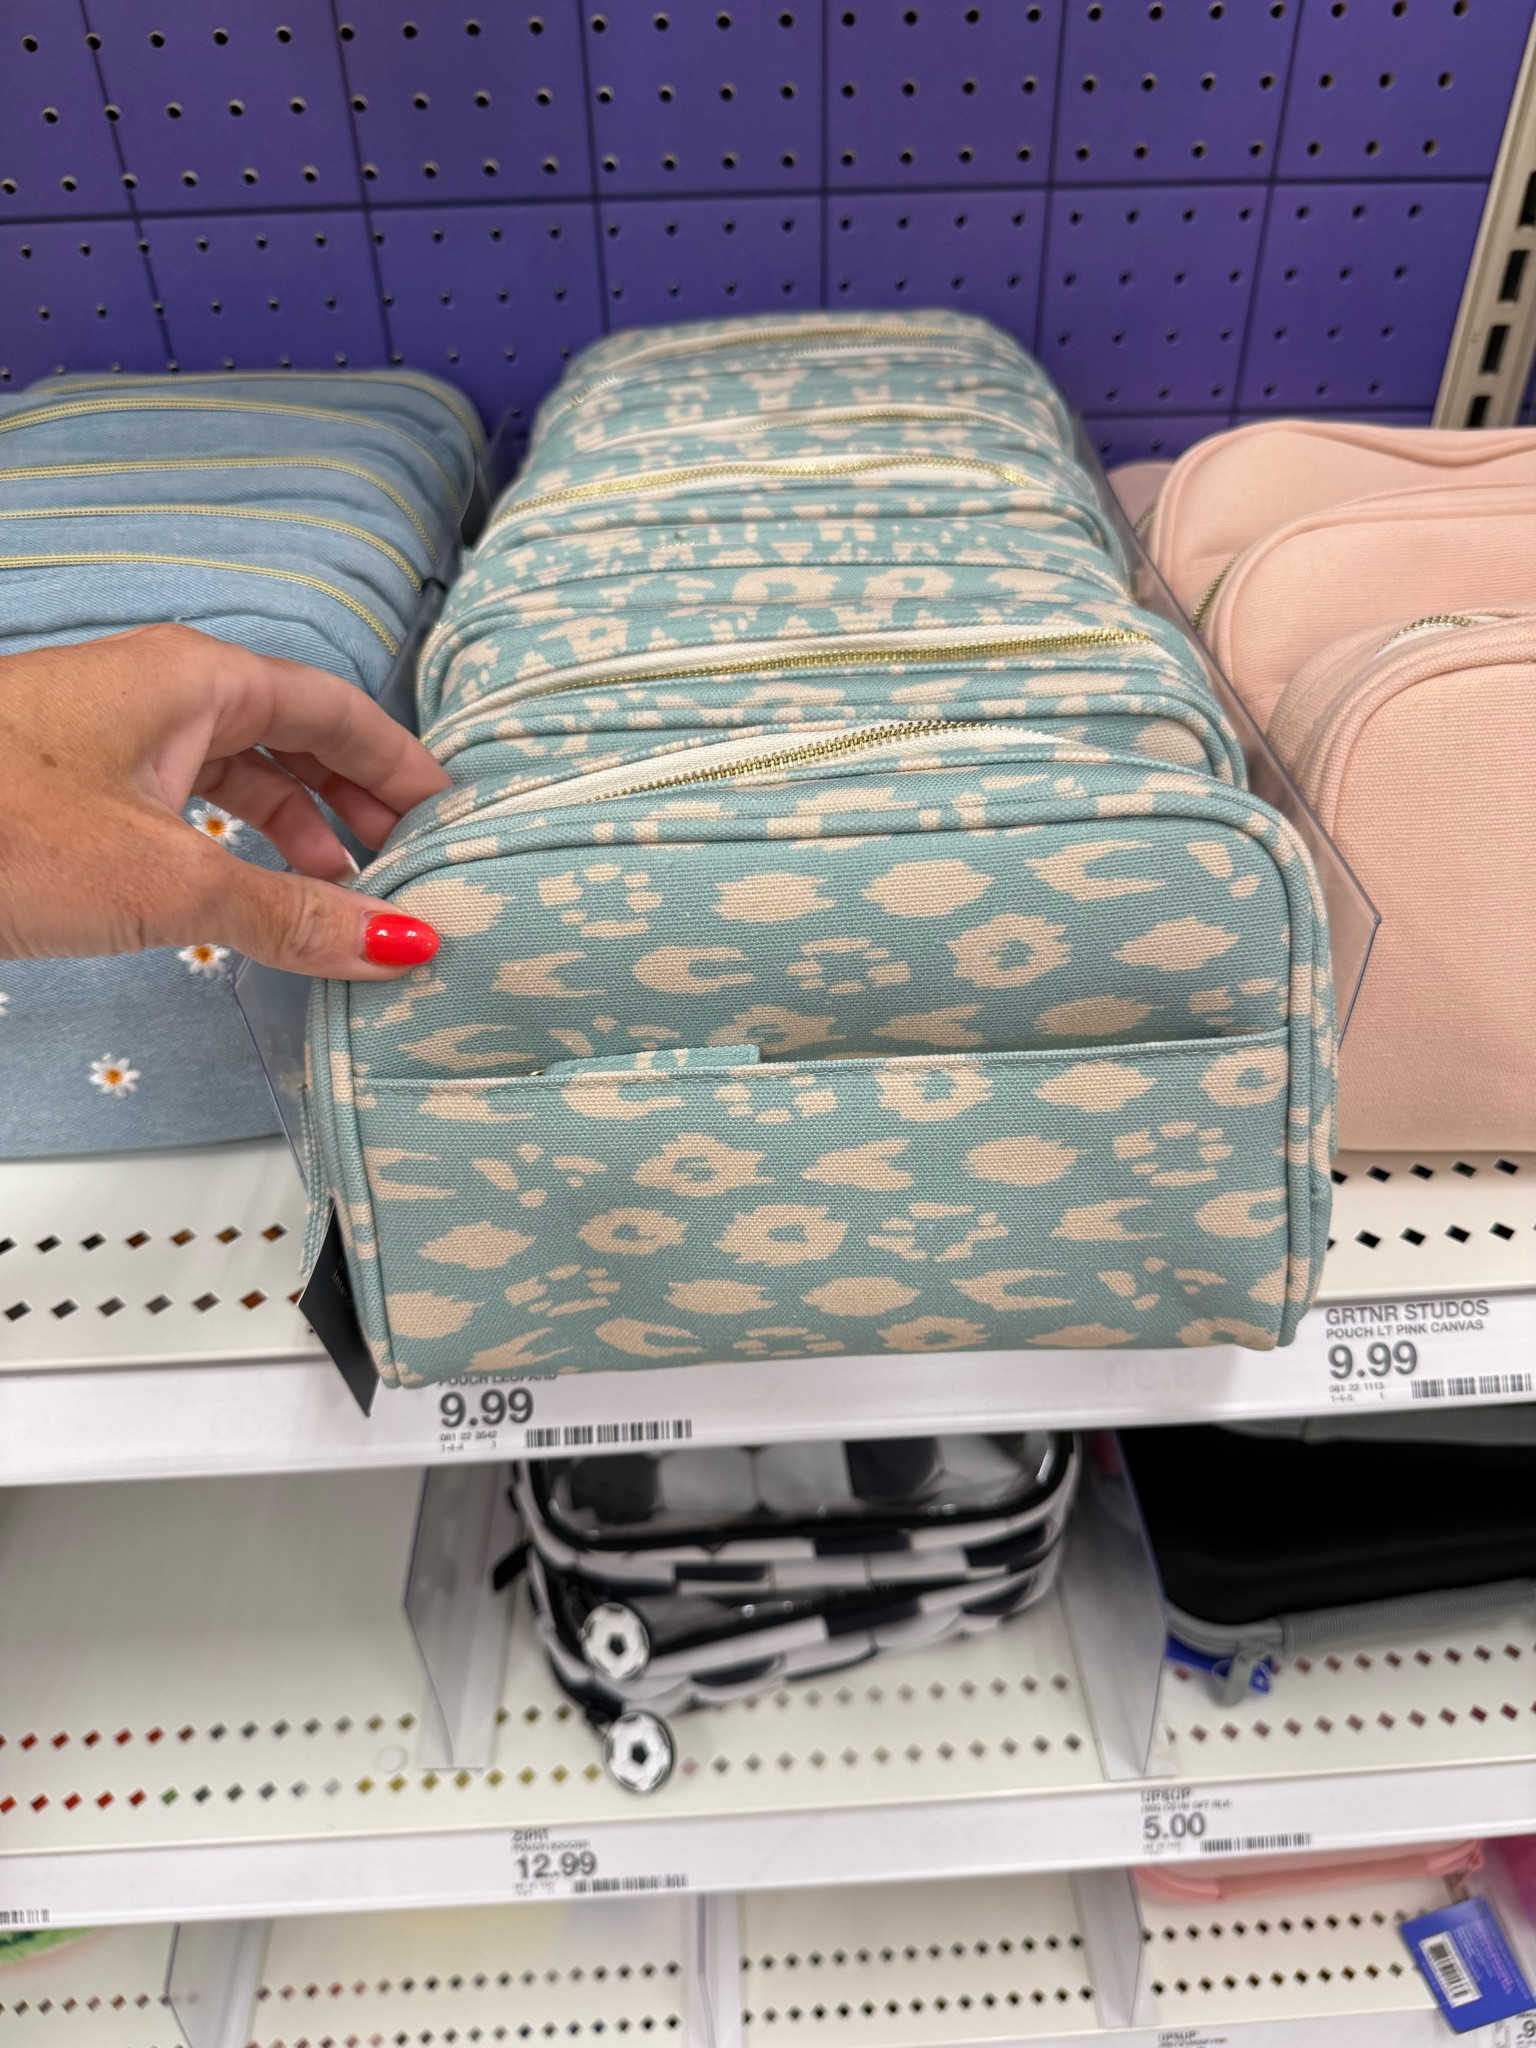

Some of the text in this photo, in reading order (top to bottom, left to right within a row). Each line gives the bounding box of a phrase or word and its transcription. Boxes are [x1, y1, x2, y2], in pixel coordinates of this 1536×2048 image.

[1325, 1299, 1490, 1325] GRTNR STUDOS
[1326, 1319, 1484, 1339] POUCH LT PINK CANVAS
[1327, 1339, 1418, 1379] 9.99
[439, 1386, 535, 1428] 9.99
[1143, 1811, 1206, 1840] 5.00
[515, 1850, 598, 1879] 12.99
